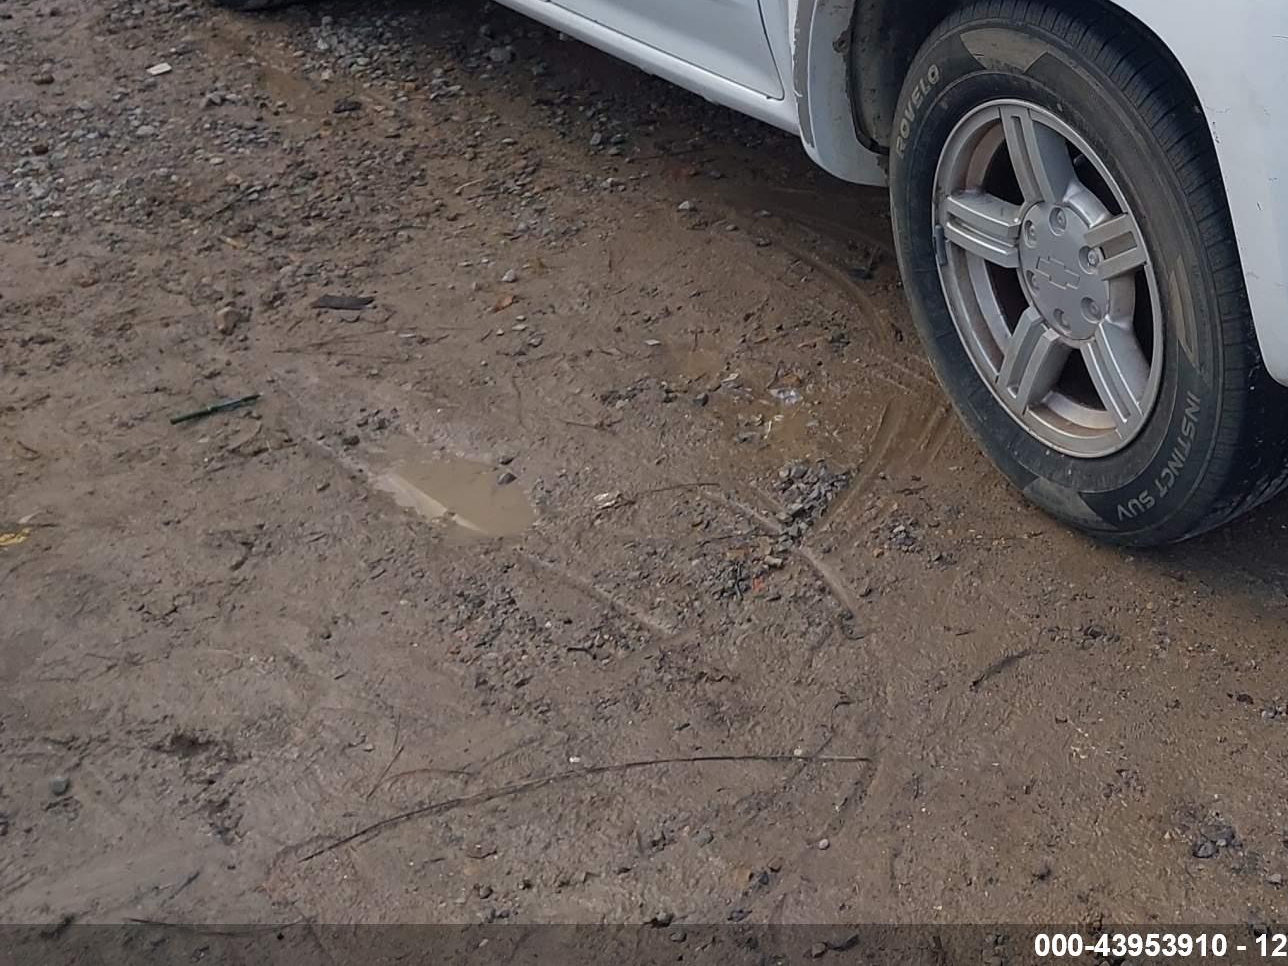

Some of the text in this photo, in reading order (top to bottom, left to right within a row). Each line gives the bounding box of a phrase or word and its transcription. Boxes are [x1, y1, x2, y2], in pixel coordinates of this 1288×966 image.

[896, 64, 940, 159] ROVELO
[1116, 390, 1201, 521] INSTINCT SUV
